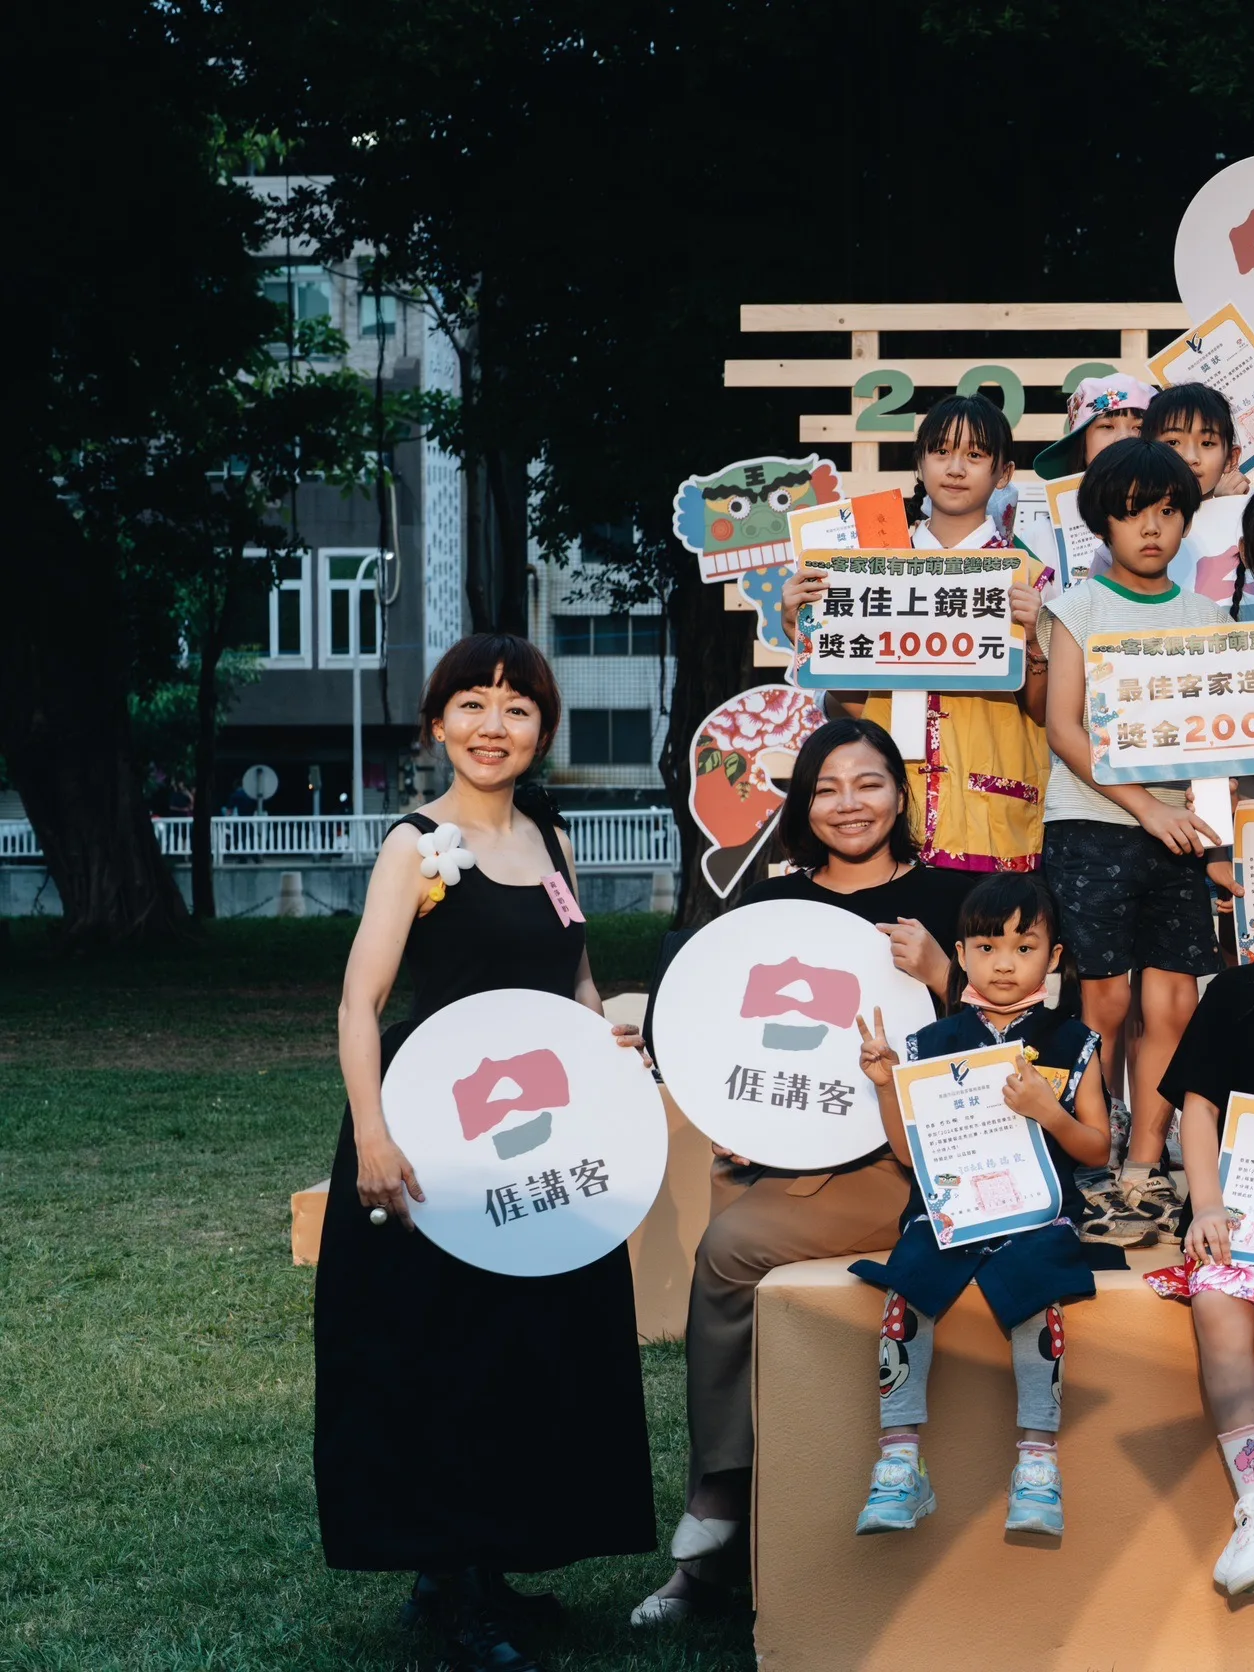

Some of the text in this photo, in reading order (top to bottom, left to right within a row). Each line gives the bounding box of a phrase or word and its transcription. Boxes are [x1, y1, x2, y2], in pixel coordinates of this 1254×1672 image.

[1200, 355, 1222, 373] 獎狀
[744, 465, 766, 487] 王
[822, 586, 1006, 618] 最佳上鏡獎
[953, 1095, 981, 1110] 獎狀
